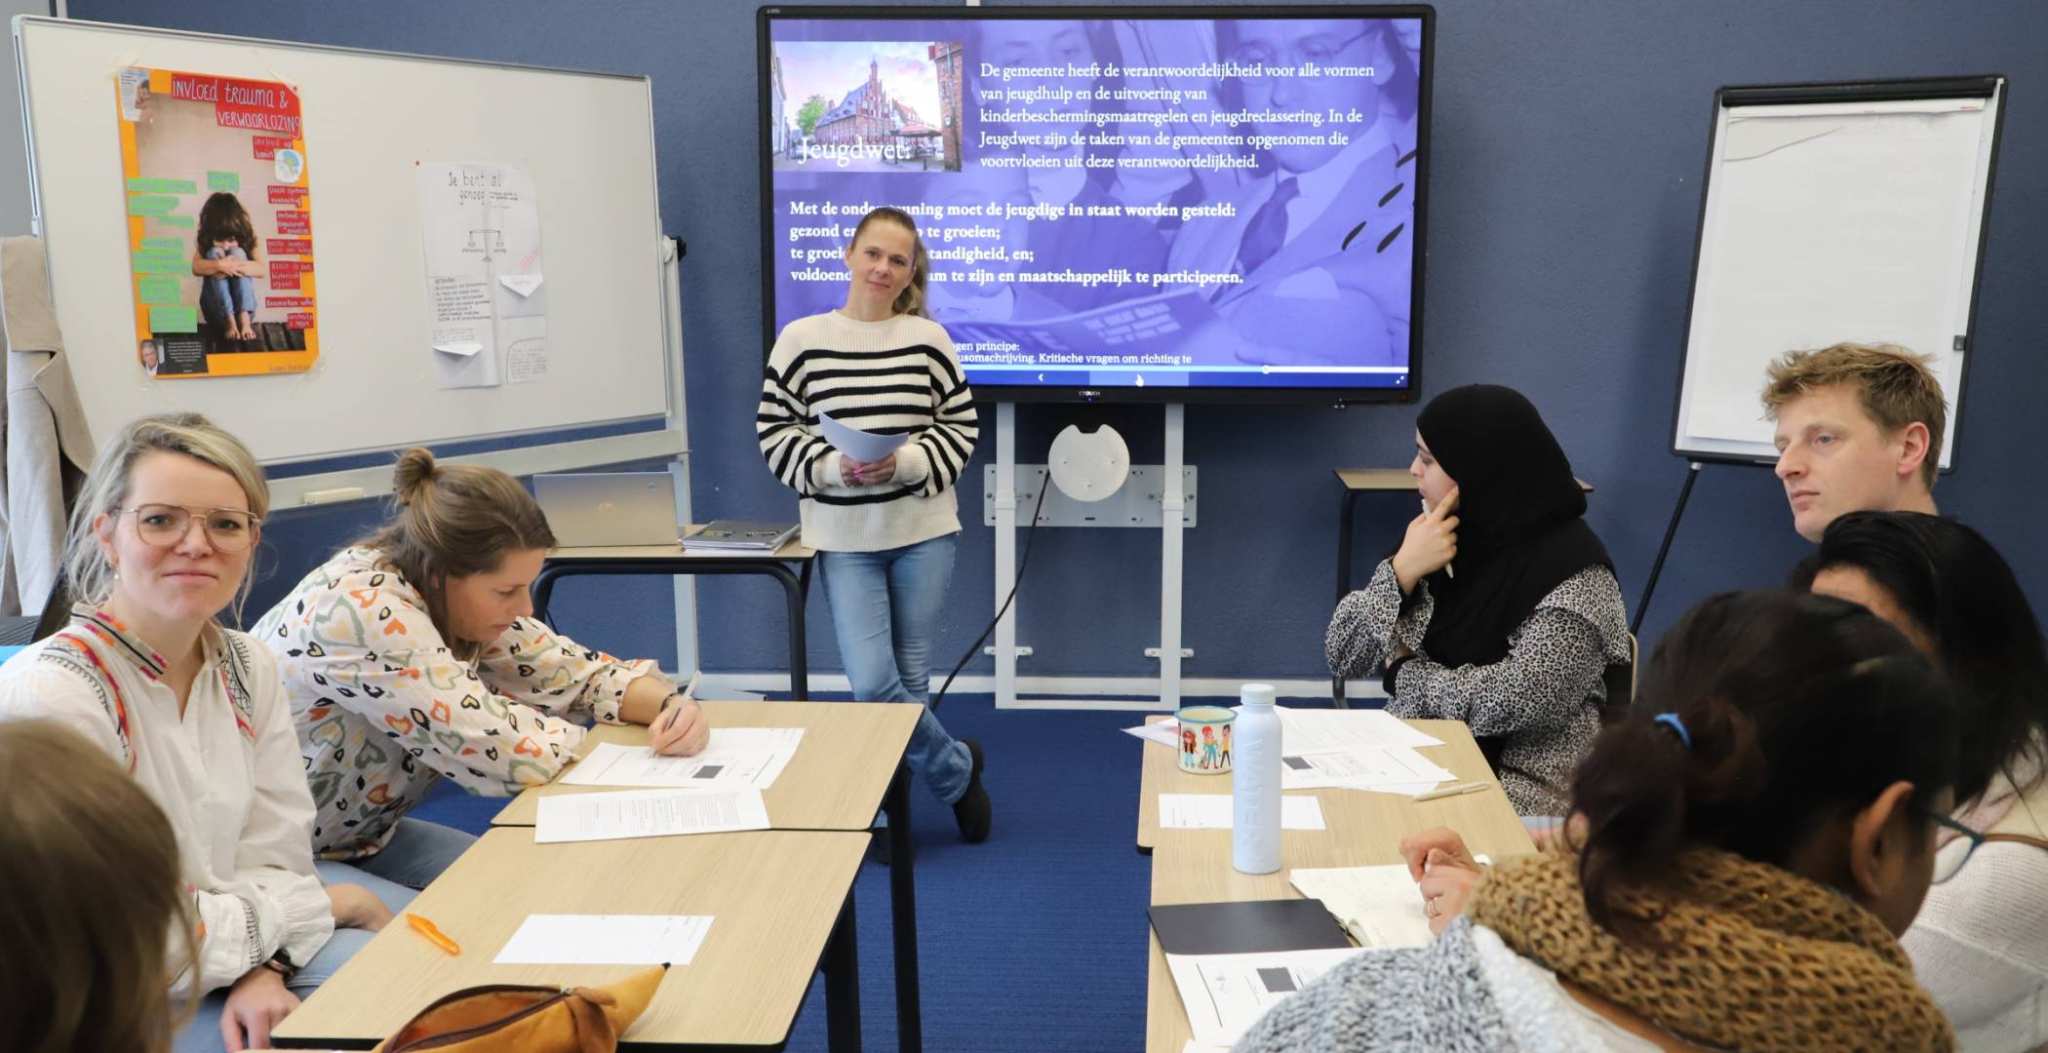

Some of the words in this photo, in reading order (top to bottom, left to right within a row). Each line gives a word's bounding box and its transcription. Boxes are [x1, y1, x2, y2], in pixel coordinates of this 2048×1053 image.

[980, 63, 1000, 77] De
[1003, 66, 1065, 81] gemeente
[1068, 63, 1101, 77] heeft
[1104, 63, 1120, 77] de
[1123, 63, 1262, 81] verantwoordelijkheid
[1265, 66, 1295, 77] voor
[1299, 63, 1320, 77] alle
[1324, 66, 1374, 77] vormen
[280, 88, 288, 109] &
[980, 89, 1002, 99] van
[1006, 86, 1073, 104] jeugdhulp
[1076, 89, 1092, 100] en
[1094, 86, 1111, 100] de
[1114, 86, 1181, 104] uitvoering
[1184, 89, 1207, 100] van
[980, 109, 1188, 127] kinderbeschermingsmaatregelen
[1192, 112, 1208, 122] en
[1210, 109, 1325, 127] jeugdreclassering.
[1328, 109, 1344, 122] In
[1347, 109, 1363, 122] de
[978, 131, 1041, 149] Jeugdwet
[1044, 132, 1067, 149] zijn
[1070, 131, 1086, 145] de
[1089, 131, 1125, 145] taken
[1128, 134, 1152, 145] van
[1154, 131, 1170, 145] de
[1173, 133, 1243, 149] gemeenten
[1247, 134, 1325, 149] opgenomen
[1328, 131, 1348, 145] die
[797, 135, 911, 167] Jeugdwet:
[980, 154, 1061, 168] voortvloeien
[1064, 154, 1082, 168] uit
[1086, 154, 1115, 168] deze
[1118, 154, 1259, 172] verantwoordelijkheid.
[790, 201, 817, 215] Met
[821, 201, 838, 215] de
[947, 203, 984, 215] moet
[986, 201, 1003, 216] de
[1006, 203, 1065, 221] jeugdige
[1069, 203, 1083, 216] in
[1087, 204, 1121, 217] staat
[1125, 202, 1178, 217] worden
[1181, 202, 1236, 221] gesteld:
[790, 224, 839, 240] gezond
[927, 227, 940, 238] te
[944, 225, 1000, 241] groeien;
[790, 247, 804, 259] te
[1013, 250, 1034, 261] en;
[952, 271, 964, 282] te
[968, 268, 995, 286] zijn
[998, 272, 1014, 282] en
[1019, 269, 1131, 287] maatschappelijk
[1136, 272, 1149, 283] te
[1152, 270, 1243, 287] participeren.
[975, 341, 1020, 352] principe:
[1039, 353, 1083, 363] Kritische
[1086, 355, 1120, 366] vragen
[1122, 356, 1138, 364] om
[1141, 354, 1180, 366] richting
[1183, 355, 1192, 364] te
